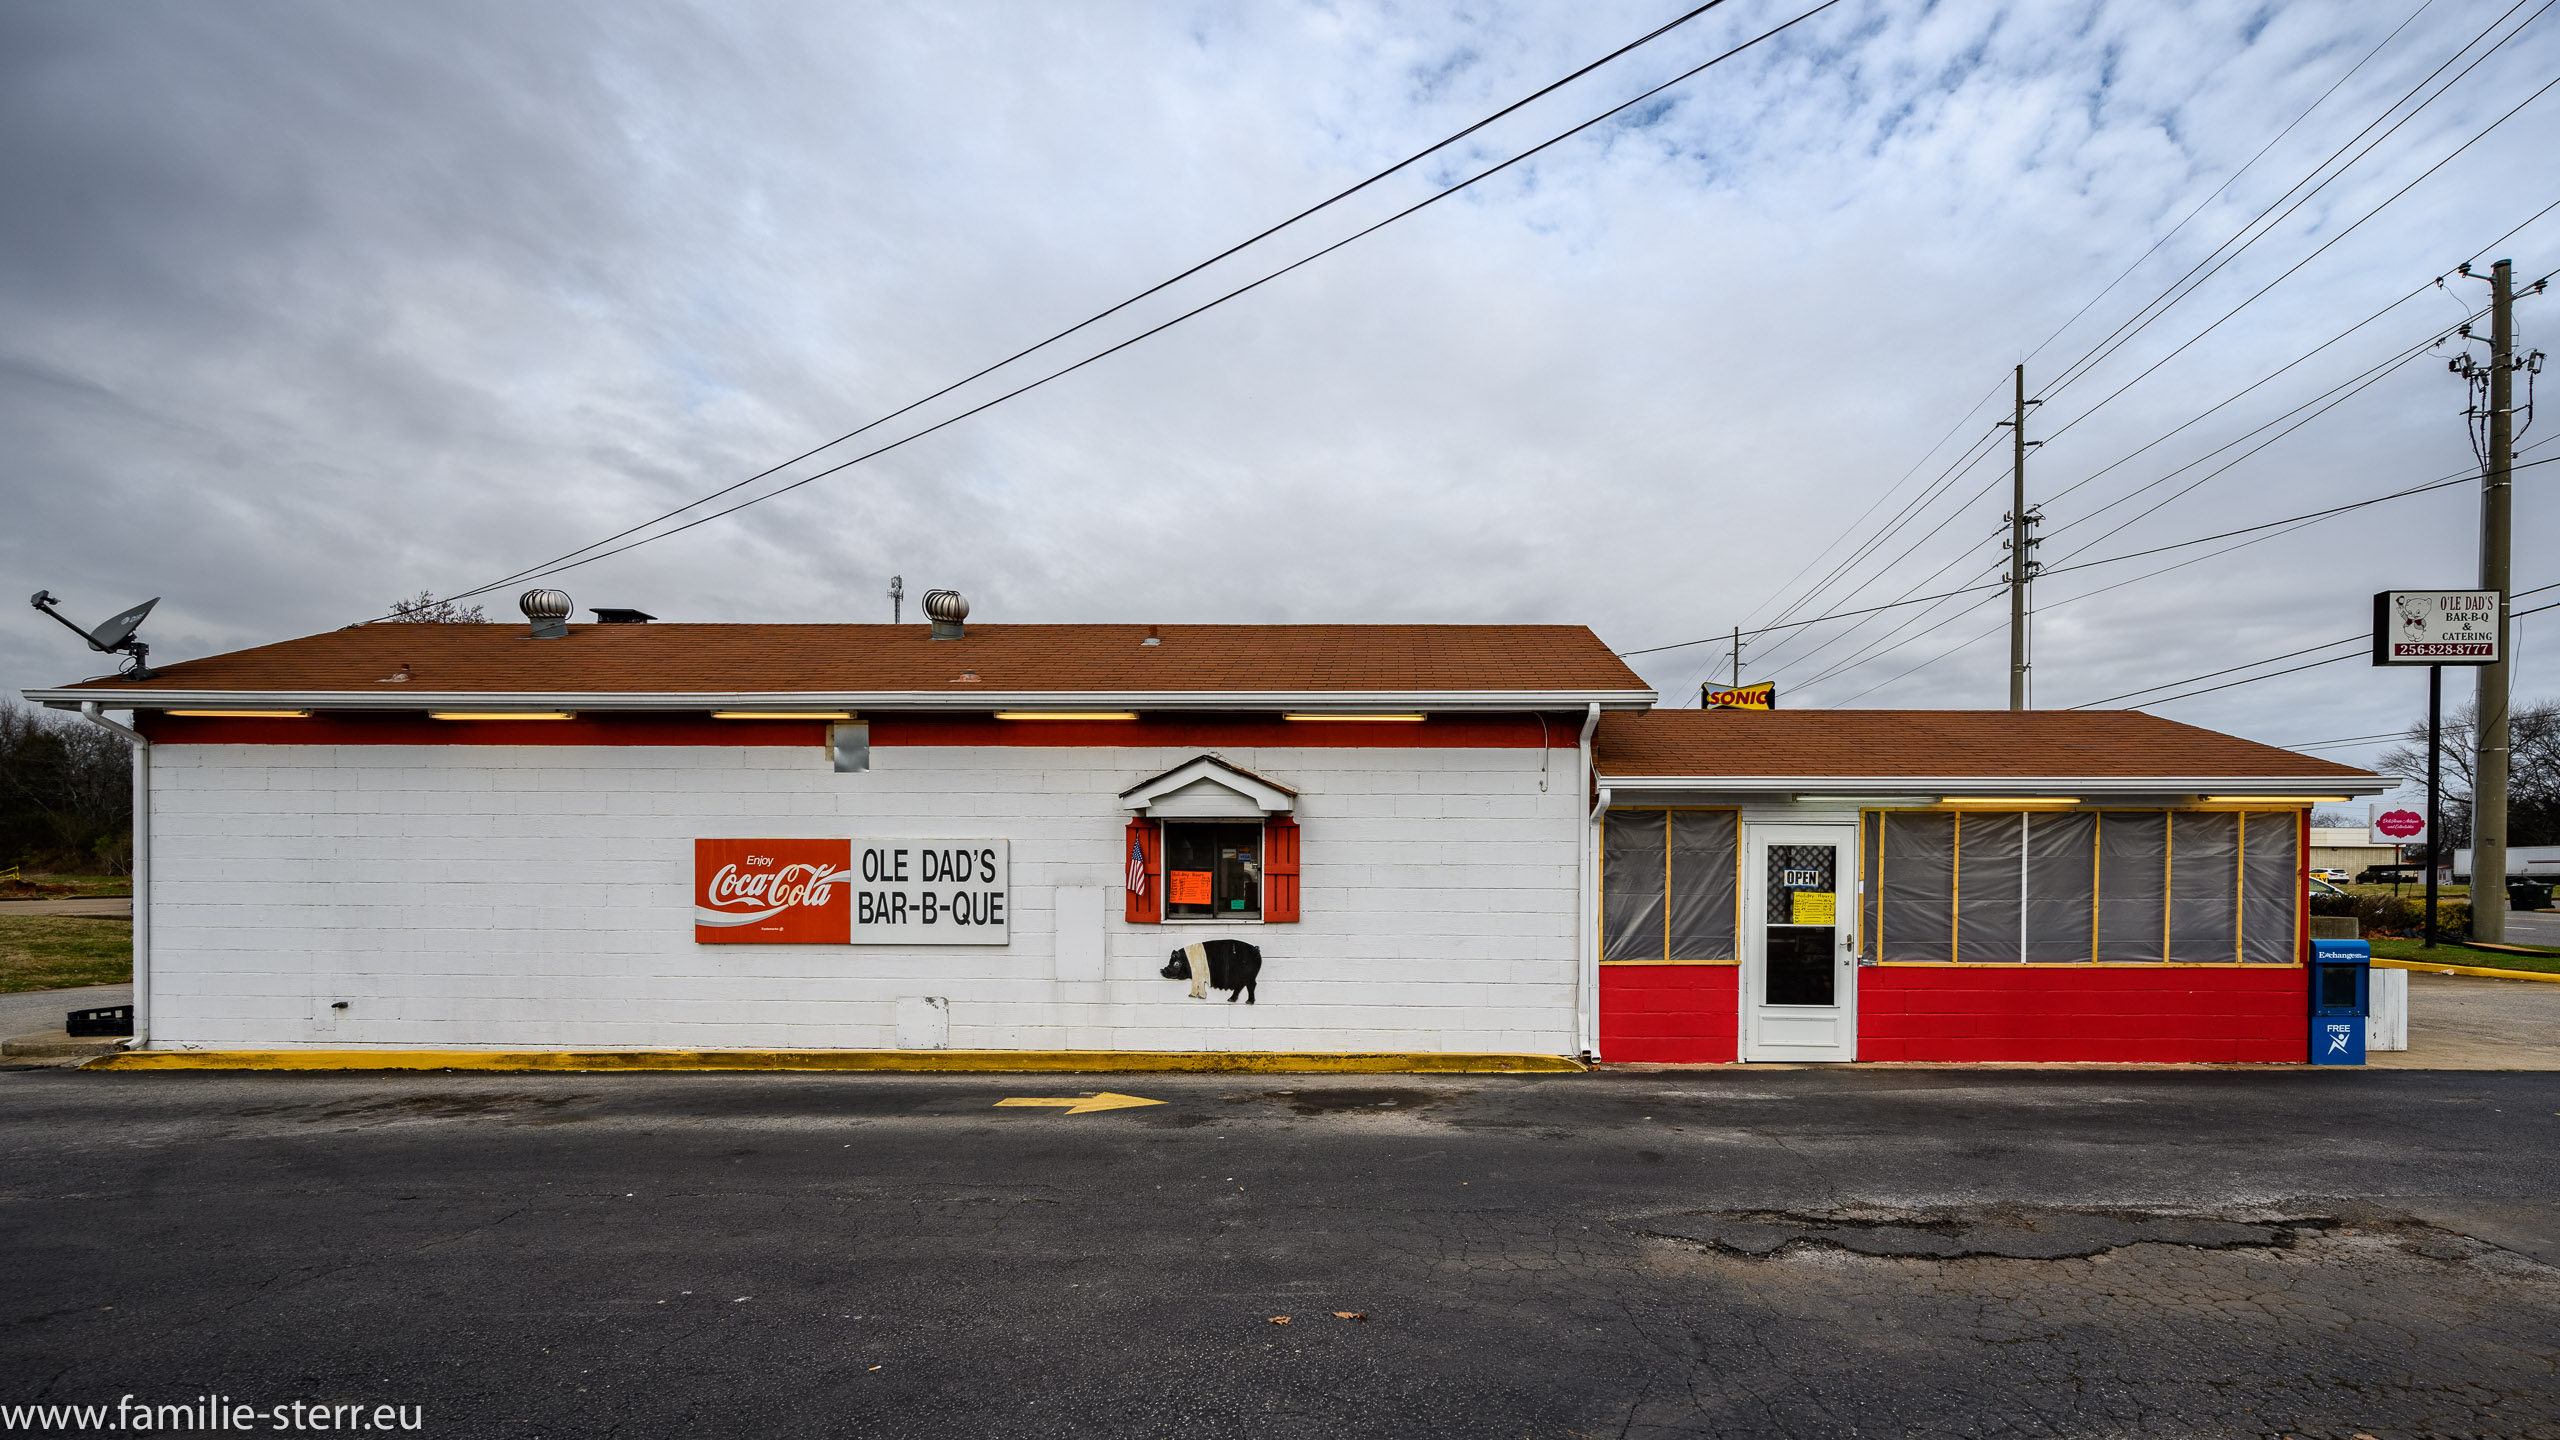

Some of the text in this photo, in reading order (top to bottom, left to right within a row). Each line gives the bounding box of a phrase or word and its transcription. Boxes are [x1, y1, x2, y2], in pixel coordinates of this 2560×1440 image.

[2440, 596, 2493, 610] O'LE DAD'S
[2446, 612, 2489, 622] BAR-B-Q
[2462, 622, 2472, 631] &
[2442, 632, 2492, 641] CATERING
[2400, 644, 2488, 655] 256-828-8777
[1709, 690, 1769, 705] SONIC
[746, 855, 774, 867] Enjoy
[862, 848, 996, 883] OLE DAD'S
[1787, 871, 1817, 885] OPEN
[708, 863, 837, 907] Coca-Cola
[858, 891, 1004, 926] BAR-B-QUE
[2327, 1024, 2351, 1033] FREE
